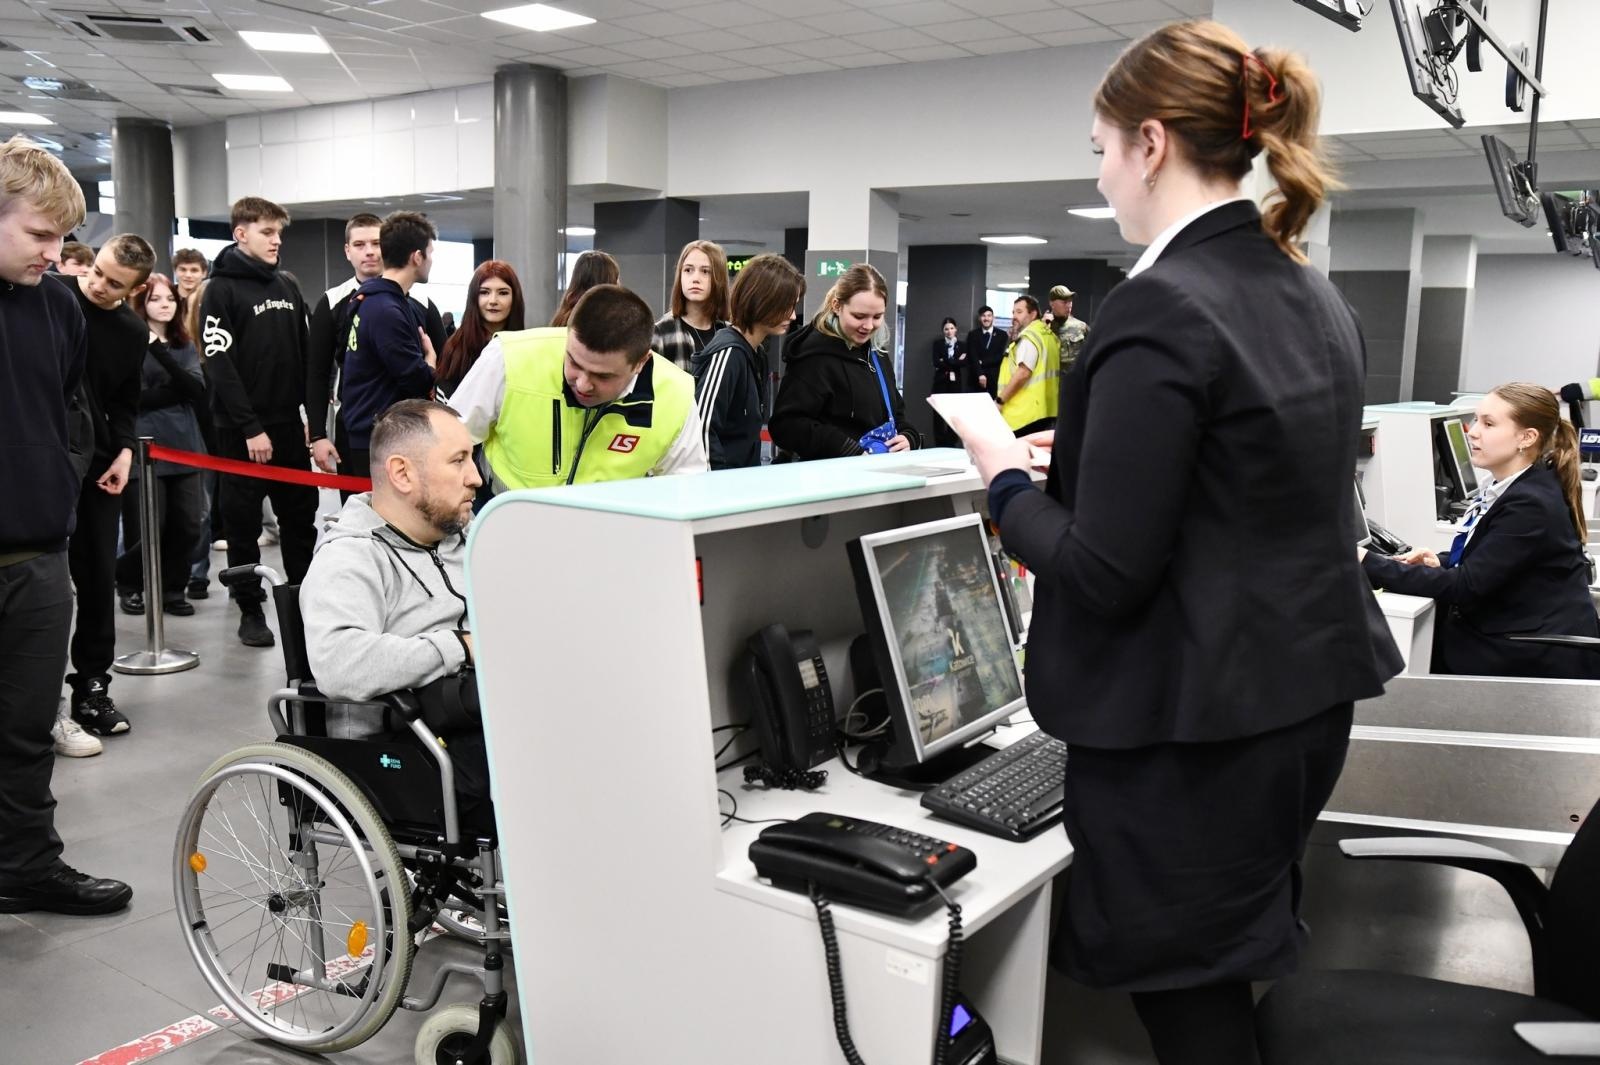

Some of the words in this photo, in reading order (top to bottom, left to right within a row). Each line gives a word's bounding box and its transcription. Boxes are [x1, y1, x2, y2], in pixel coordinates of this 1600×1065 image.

[253, 303, 266, 316] Los
[266, 299, 294, 311] Angeles
[611, 436, 637, 451] LS
